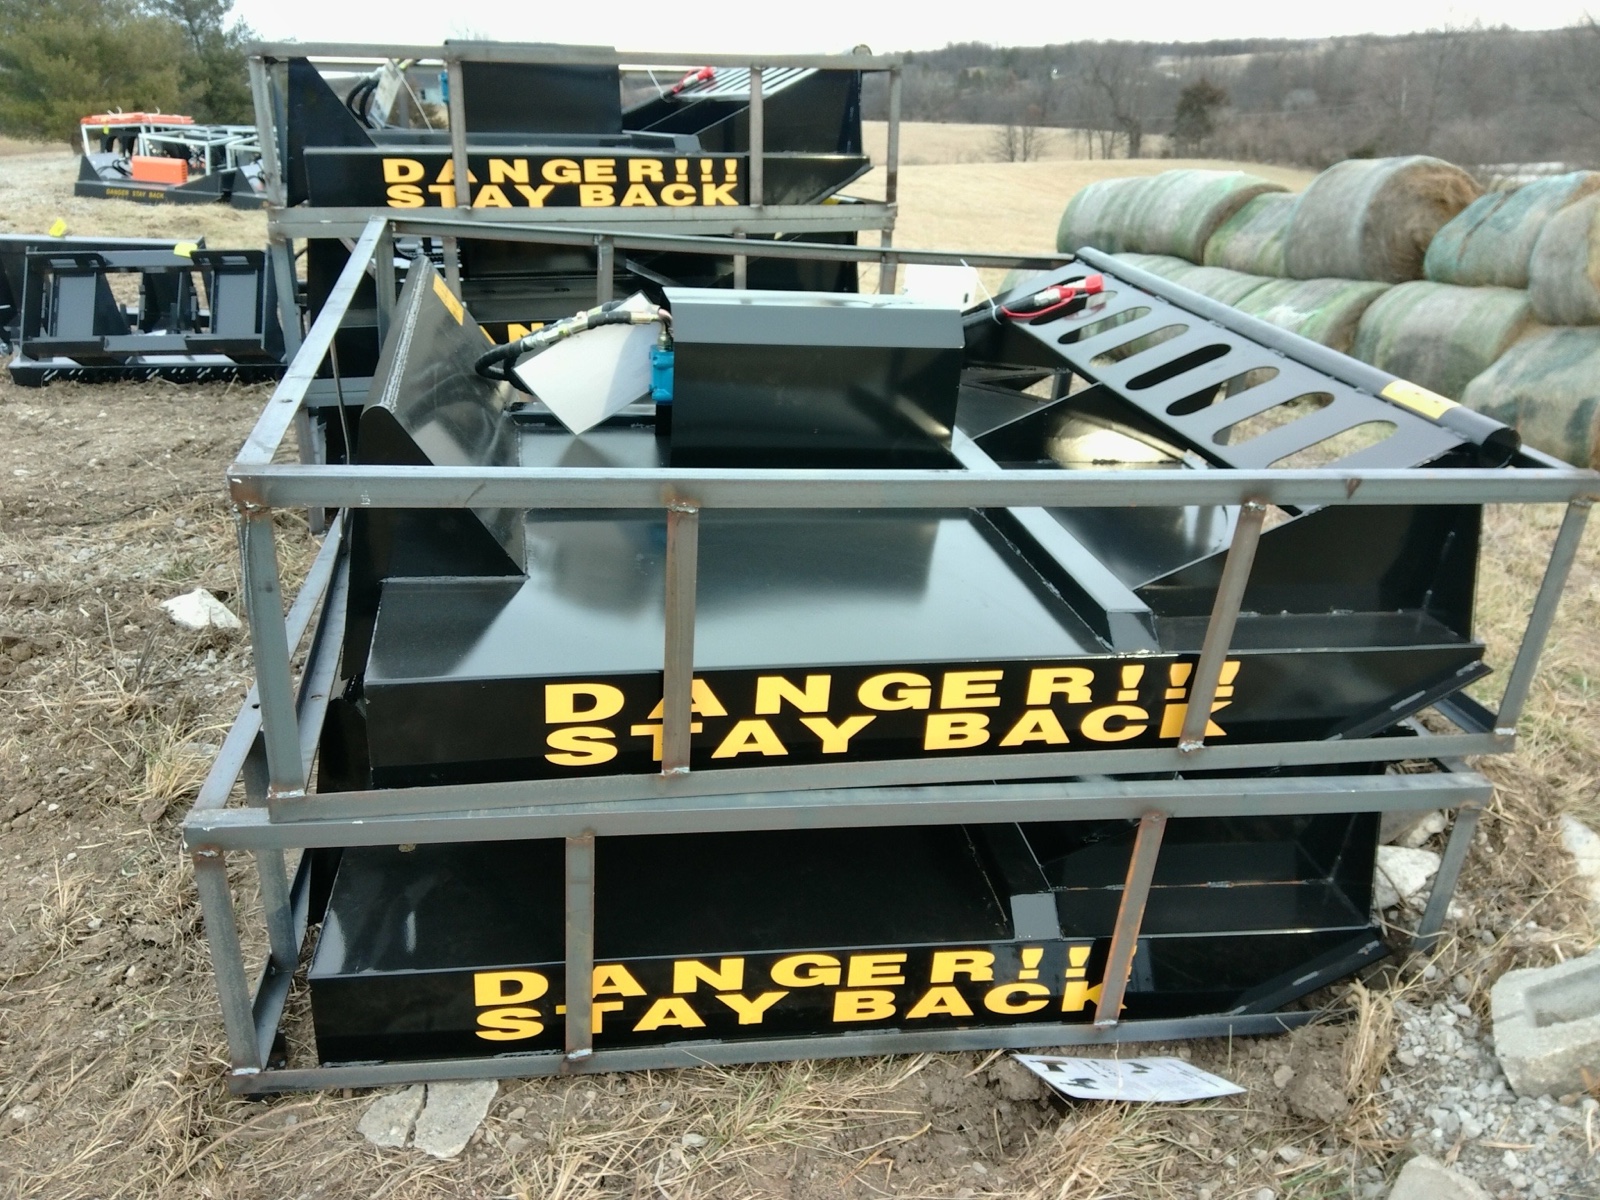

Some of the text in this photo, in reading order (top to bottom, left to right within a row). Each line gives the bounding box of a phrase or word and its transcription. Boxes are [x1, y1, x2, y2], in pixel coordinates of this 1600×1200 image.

[382, 158, 738, 183] DANGER!!!
[106, 188, 165, 199] DANGER STAY BACK
[386, 183, 739, 208] STAY BACK
[545, 661, 1241, 724] DANGER!!!
[544, 701, 1233, 766] STAY BACK
[474, 946, 1138, 1007] DANGER!!
[833, 980, 1127, 1023] BACK
